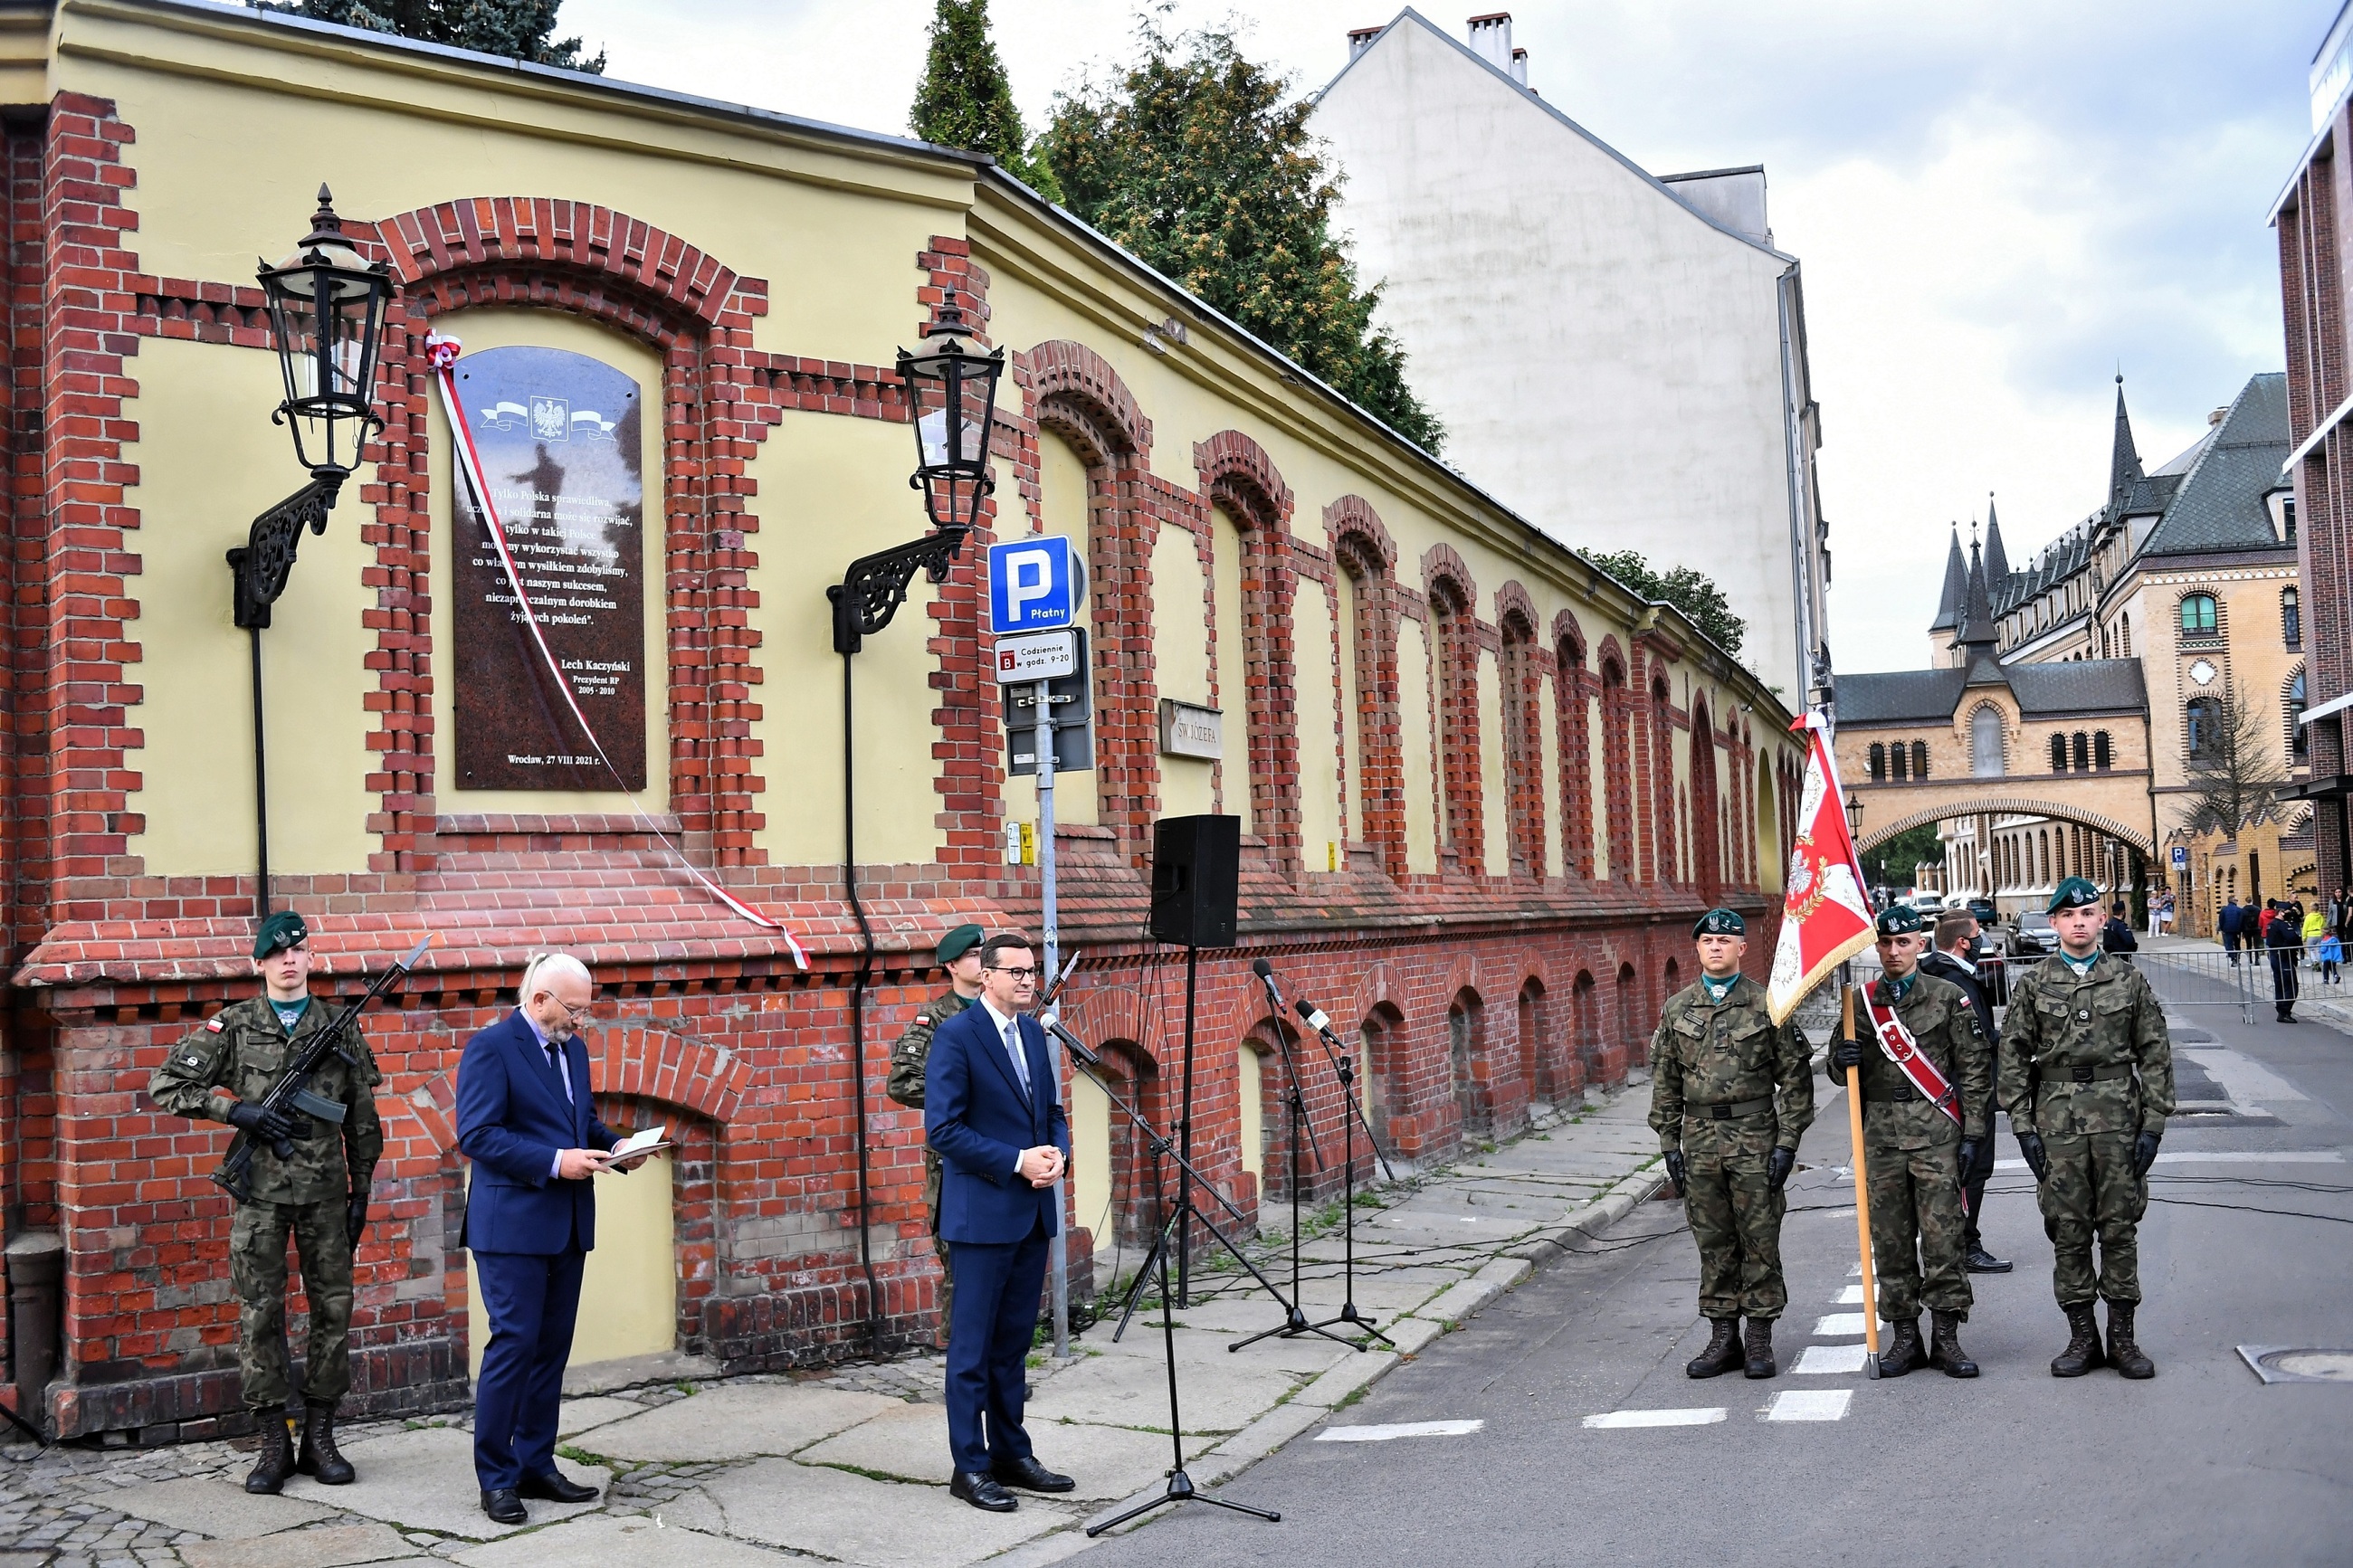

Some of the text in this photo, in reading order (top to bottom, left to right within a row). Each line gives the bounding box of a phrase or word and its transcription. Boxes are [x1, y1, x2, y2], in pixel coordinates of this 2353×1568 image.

[521, 489, 549, 501] Polska
[551, 494, 613, 509] sprawiedliwa,
[466, 505, 501, 515] ucza
[510, 507, 551, 518] solidarna
[554, 510, 577, 521] może
[579, 512, 592, 523] się
[594, 515, 633, 527] rozwijać,
[505, 524, 596, 540] tylko w takiej Polsce
[481, 541, 619, 559] momy wykorzystać wszystko
[472, 557, 483, 566] co
[529, 560, 575, 573] wysiłkiem
[576, 563, 628, 577] zdobyliśmy,
[495, 577, 507, 585] co
[527, 578, 560, 590] naszym
[563, 580, 607, 594] sukcesem,
[1006, 549, 1053, 622] P
[485, 592, 617, 609] niezaprczalnym dorobkiem
[510, 611, 549, 623] żyjąych
[1032, 608, 1065, 620] Płatny
[1021, 644, 1063, 656] Codziennie
[561, 659, 631, 673] Lech Kaczyński
[1004, 658, 1011, 670] B
[1026, 658, 1046, 668] godz.
[1051, 654, 1070, 663] 9-20
[573, 675, 620, 685] Prezydent RP
[578, 686, 595, 695] 2005
[599, 687, 615, 695] 2010
[508, 755, 601, 765] Wrocław, 27 VIII 2021 r.
[2174, 848, 2182, 861] P
